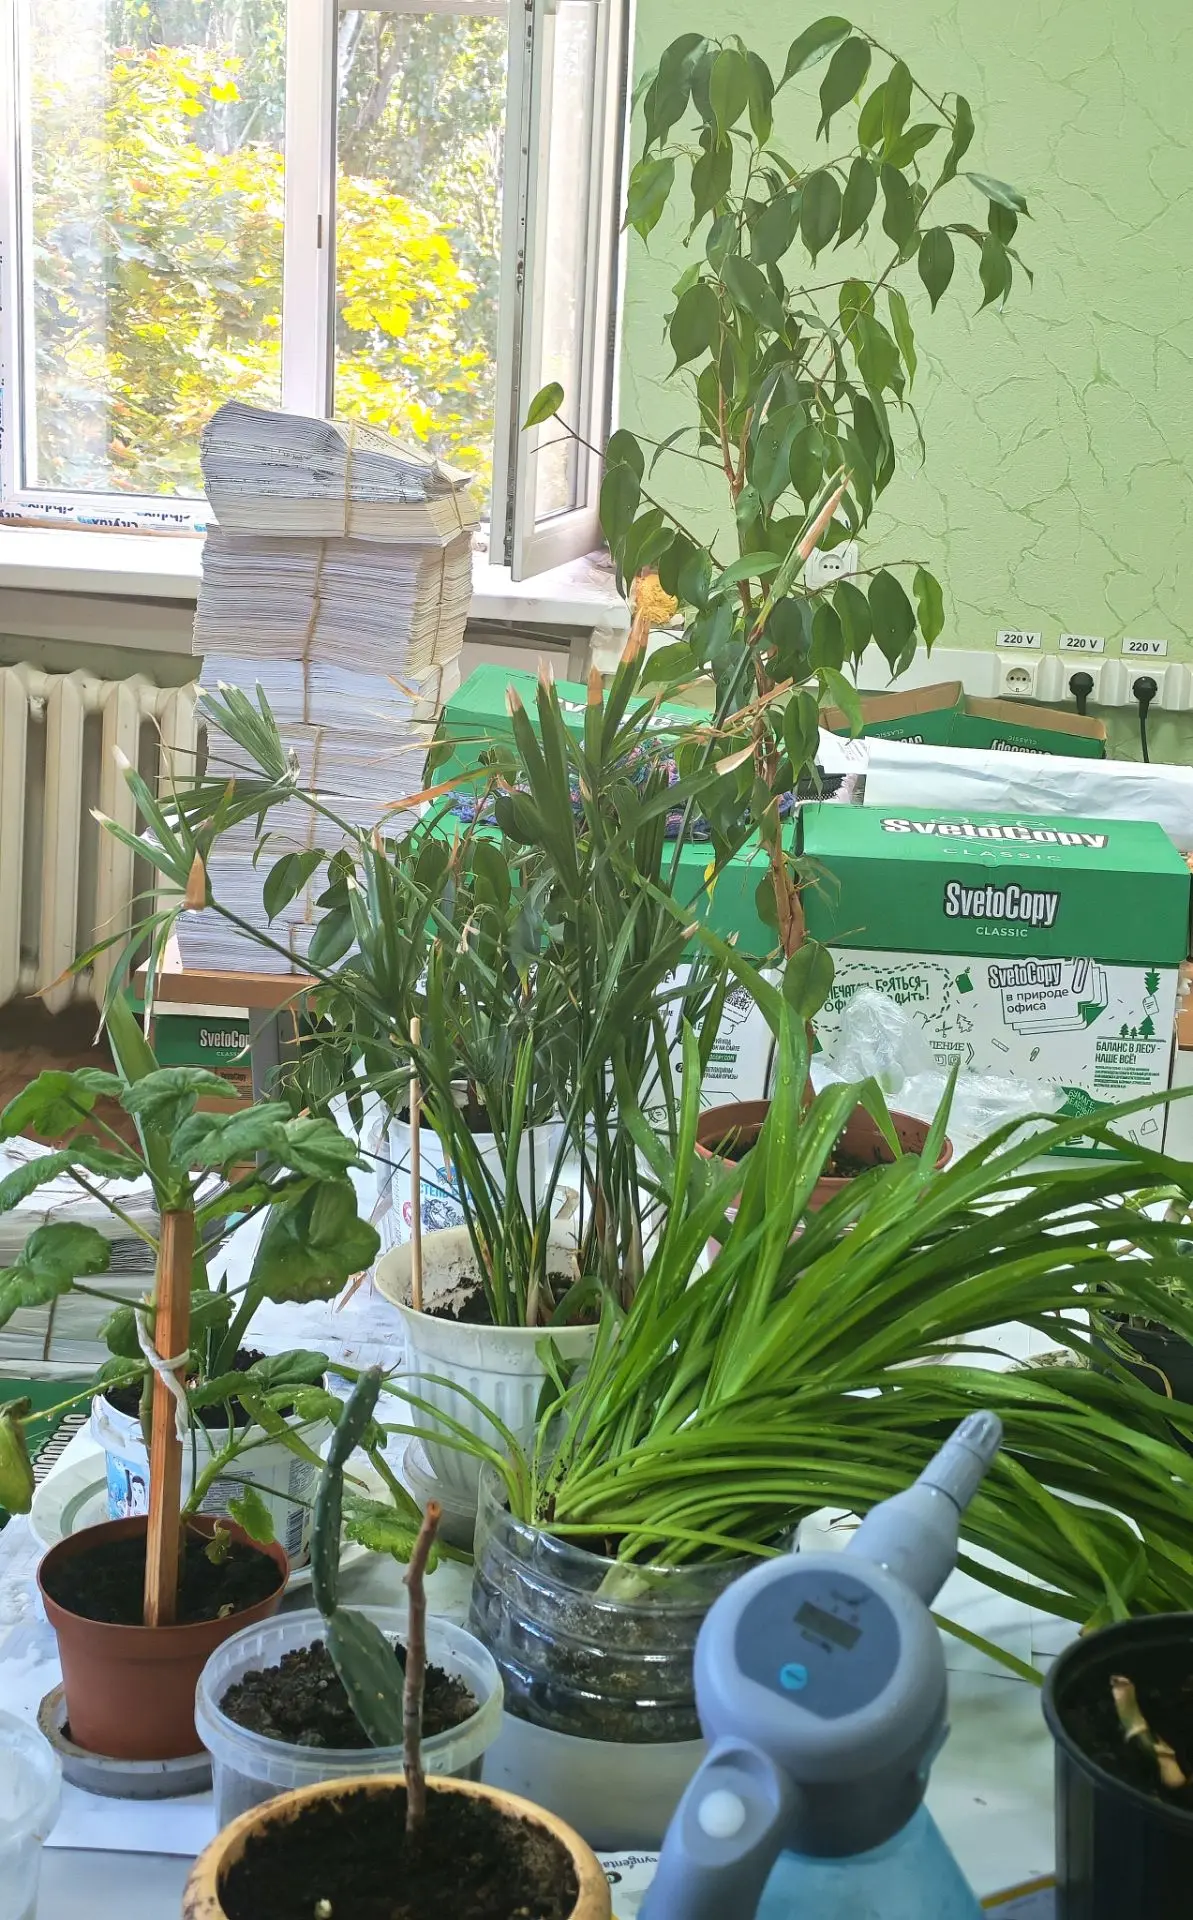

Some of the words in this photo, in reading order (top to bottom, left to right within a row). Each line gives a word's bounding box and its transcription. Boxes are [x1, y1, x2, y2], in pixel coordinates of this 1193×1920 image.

[1003, 634, 1023, 644] 220
[1026, 635, 1035, 645] V
[1066, 637, 1086, 648] 220
[1089, 639, 1098, 649] V
[1129, 641, 1149, 652] 220
[1152, 643, 1161, 652] V
[880, 818, 1109, 848] SvetoCopy
[943, 848, 1063, 862] CLASSIC
[945, 881, 1060, 927] SvetoCopy
[975, 926, 1028, 938] CLASSIC
[988, 962, 1062, 988] SvetoCopy
[1006, 993, 1013, 1001] в
[1017, 988, 1069, 1002] природе
[1007, 1002, 1047, 1015] офиса
[1096, 1041, 1128, 1053] БАЛАНС
[1128, 1043, 1135, 1053] В
[1135, 1043, 1156, 1054] ЛЕСУ
[1095, 1053, 1118, 1064] НАШЕ
[1119, 1053, 1137, 1065] ВСЁ!
[602, 1856, 658, 1869] syngenta
